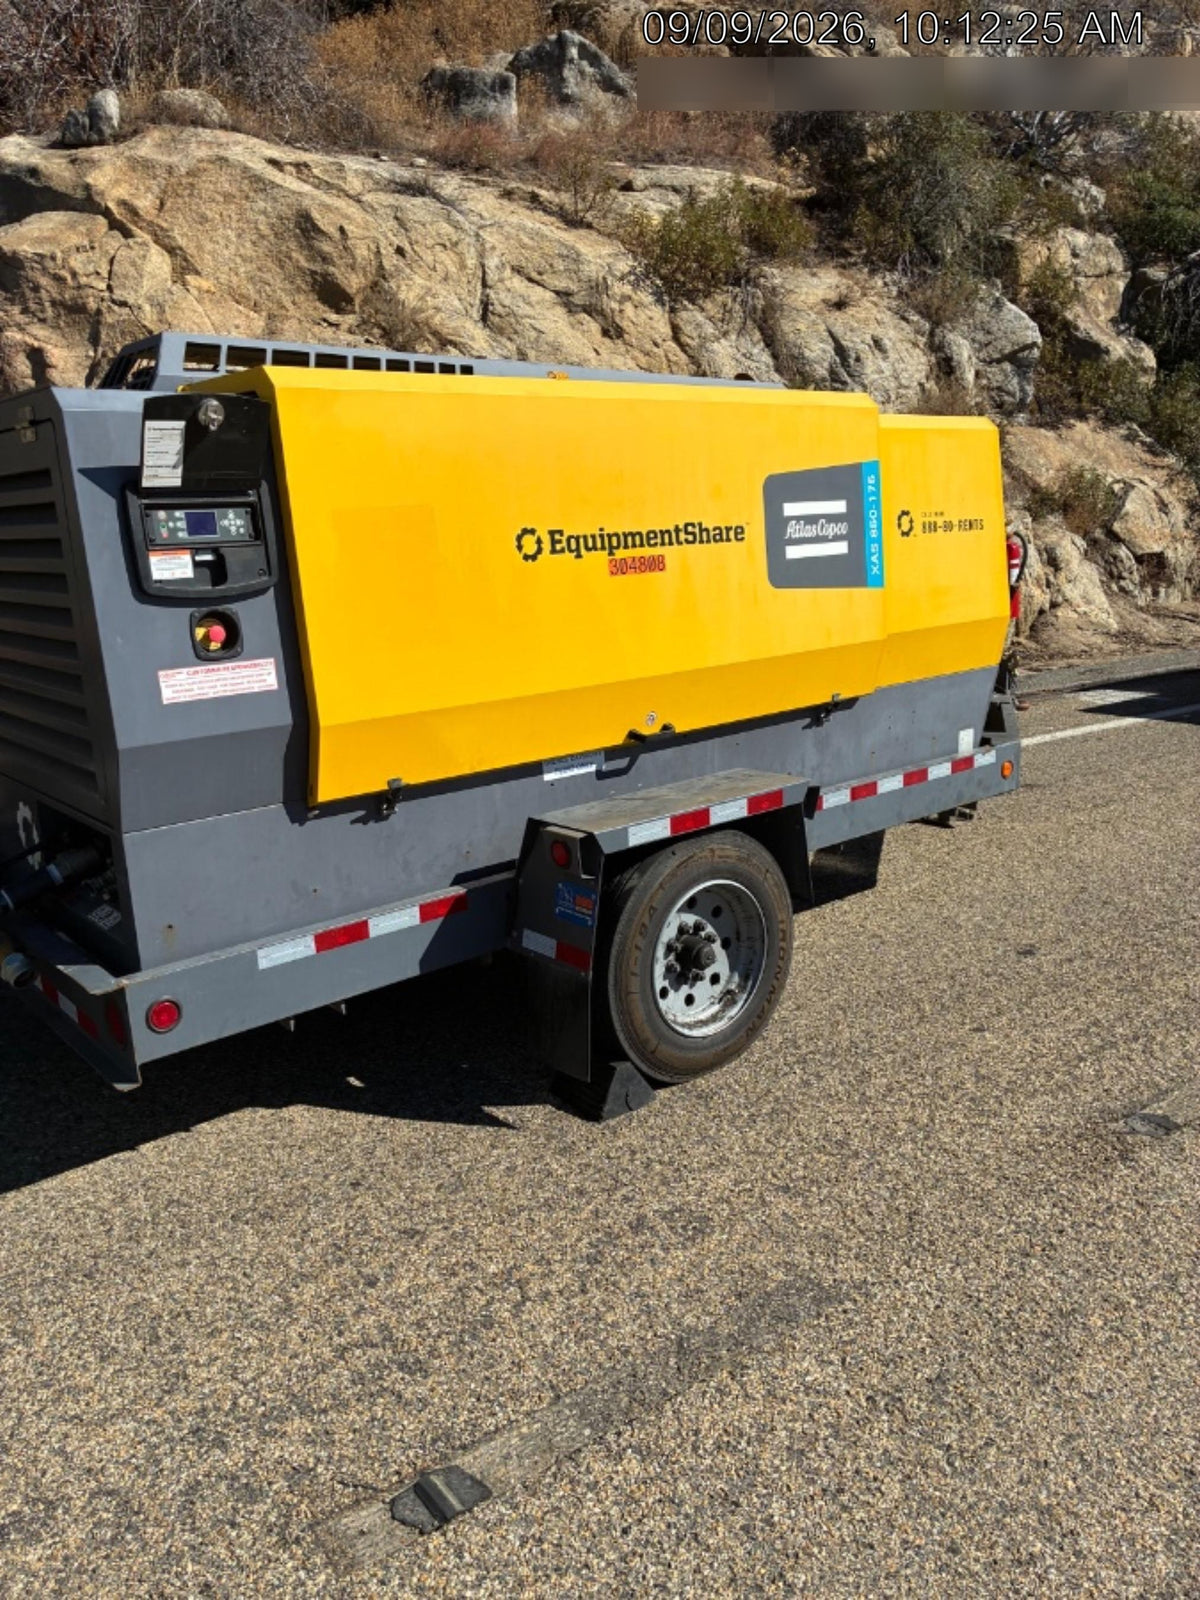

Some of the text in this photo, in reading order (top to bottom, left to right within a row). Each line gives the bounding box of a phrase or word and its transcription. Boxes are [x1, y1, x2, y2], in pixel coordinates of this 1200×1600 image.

[547, 521, 746, 559] EquipmentShare
[608, 554, 666, 576] 304808
[871, 543, 880, 575] XAS
